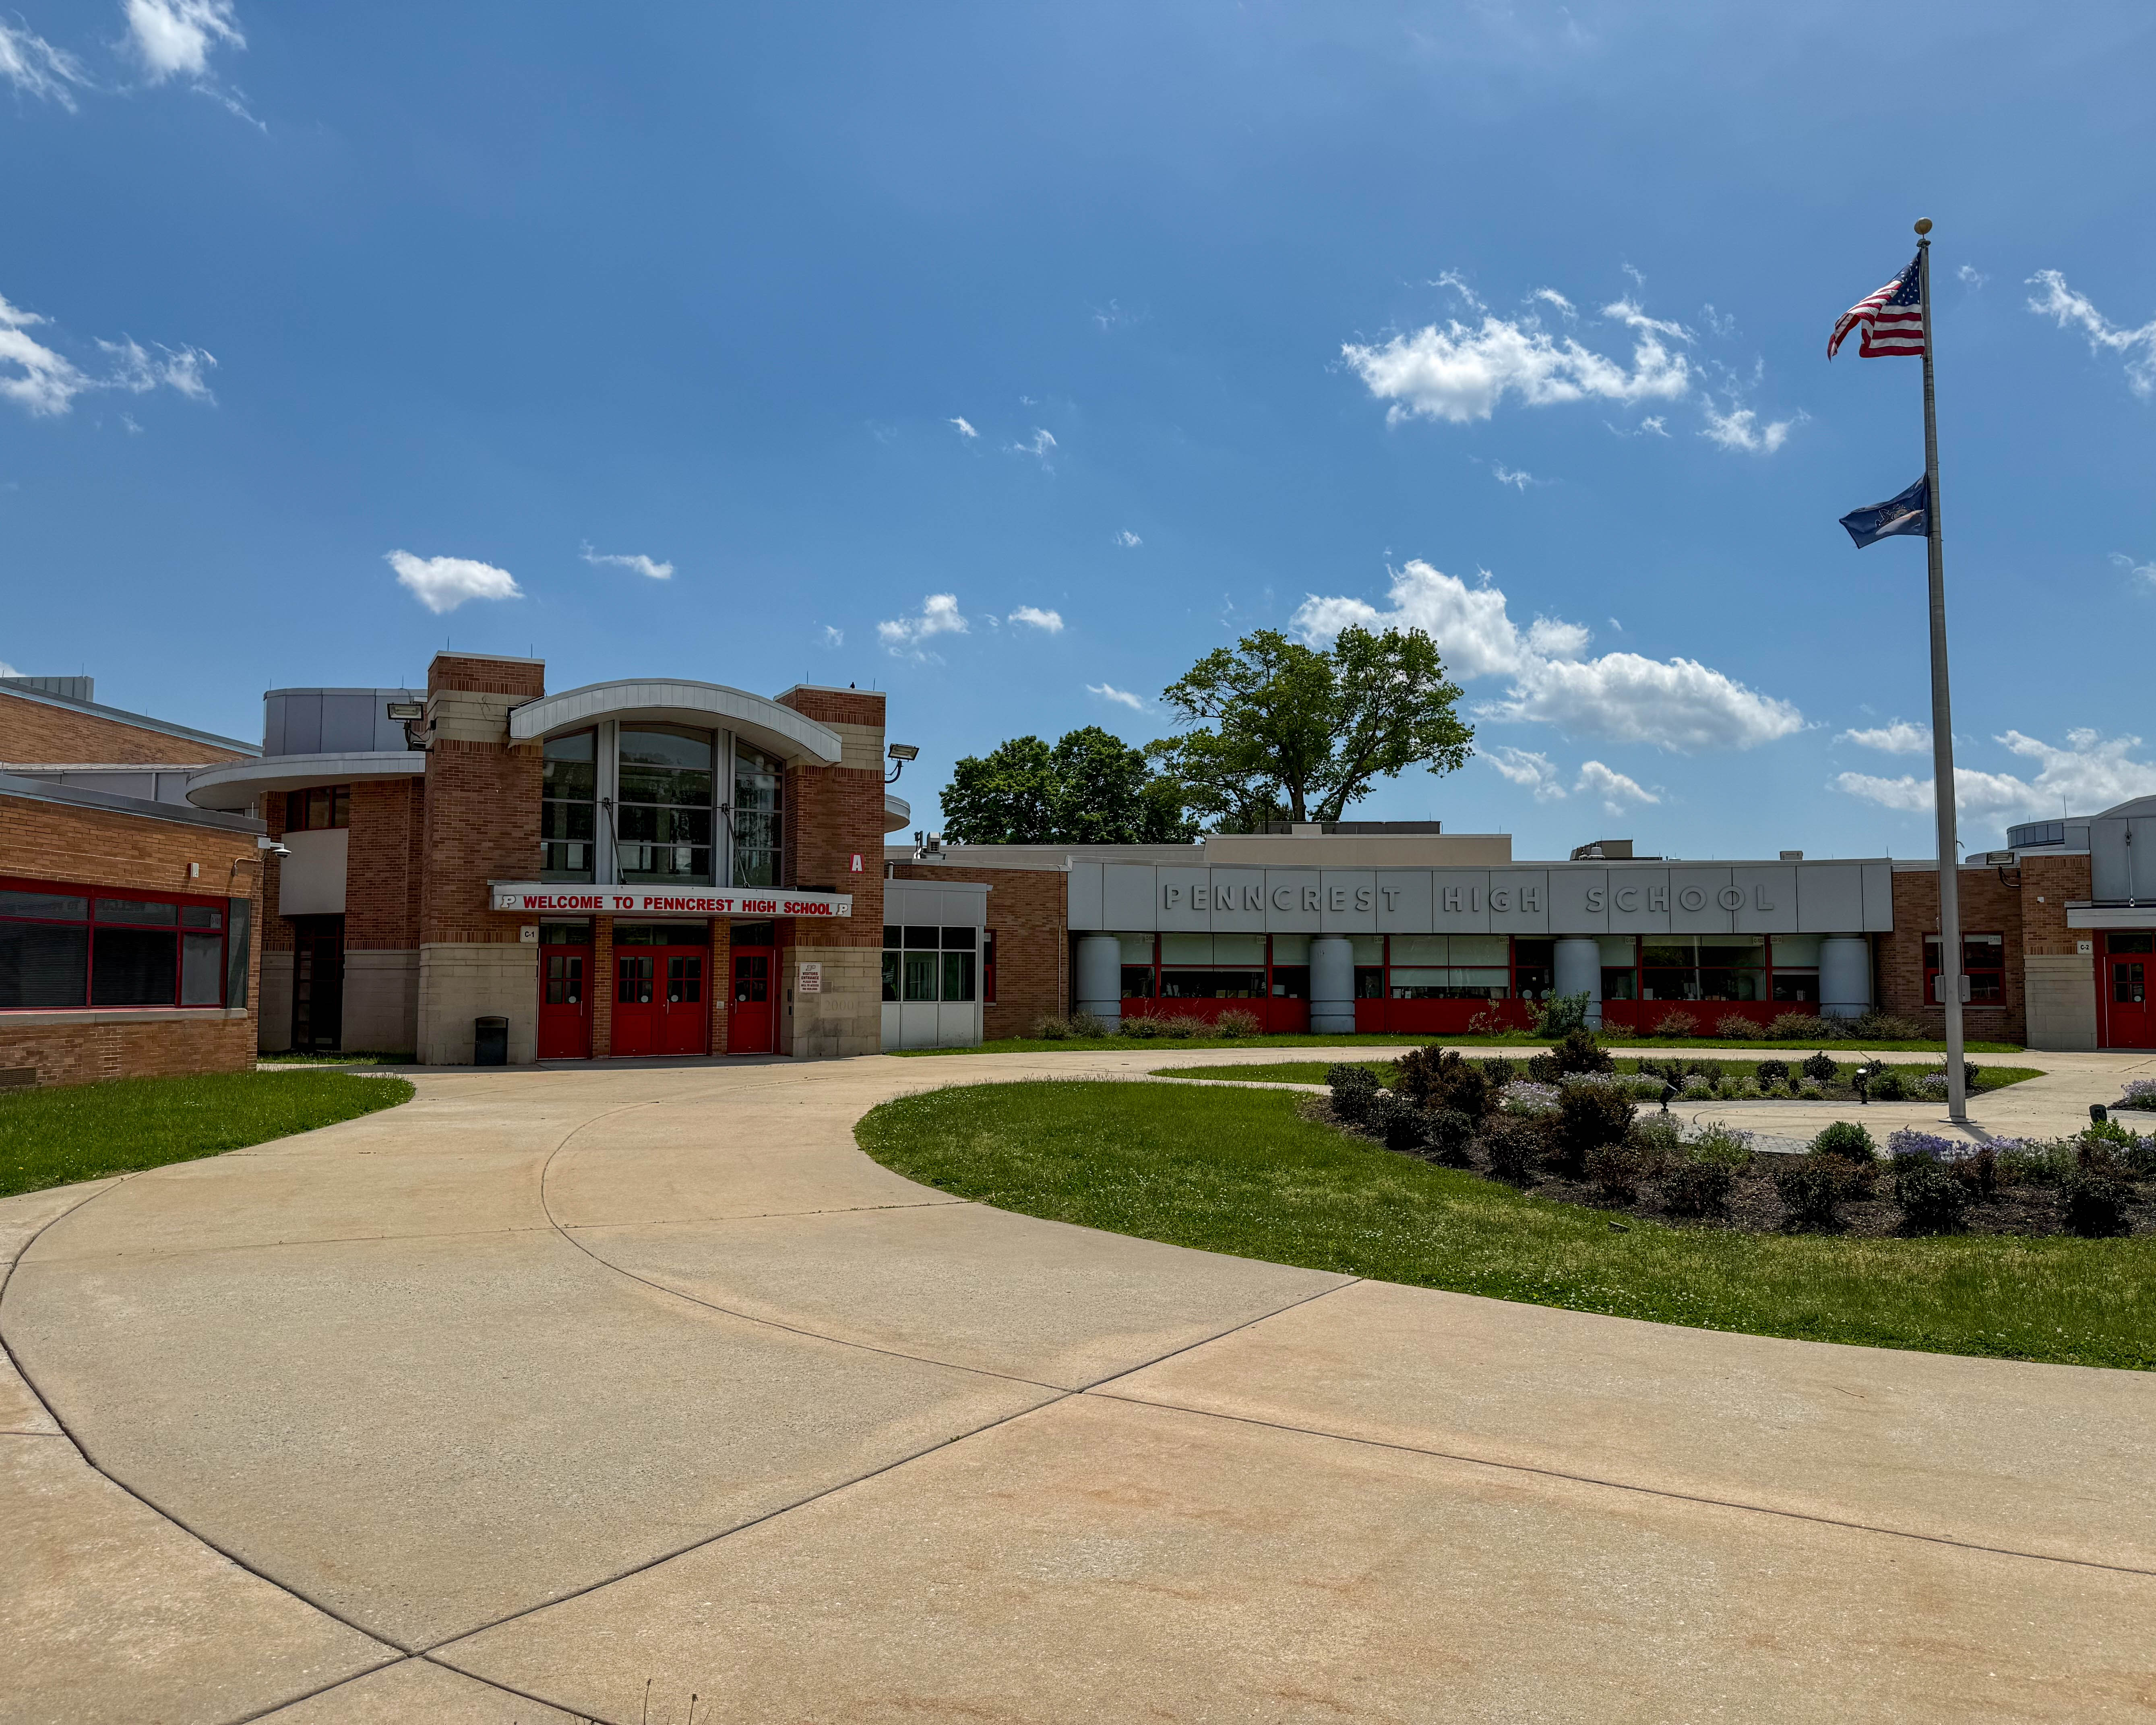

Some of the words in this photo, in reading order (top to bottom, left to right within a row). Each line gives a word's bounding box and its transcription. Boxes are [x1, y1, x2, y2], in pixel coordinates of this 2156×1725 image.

[852, 854, 862, 871] A
[523, 896, 603, 909] WELCOME
[613, 897, 634, 909] TO
[644, 898, 734, 911] PENNCREST
[742, 900, 776, 913] HIGH
[784, 902, 832, 915] SCHOOL
[1164, 884, 1400, 912] PENNCREST
[1444, 886, 1540, 912] HIGH
[1586, 884, 1774, 912] SCHOOL
[825, 1000, 854, 1011] 2000
